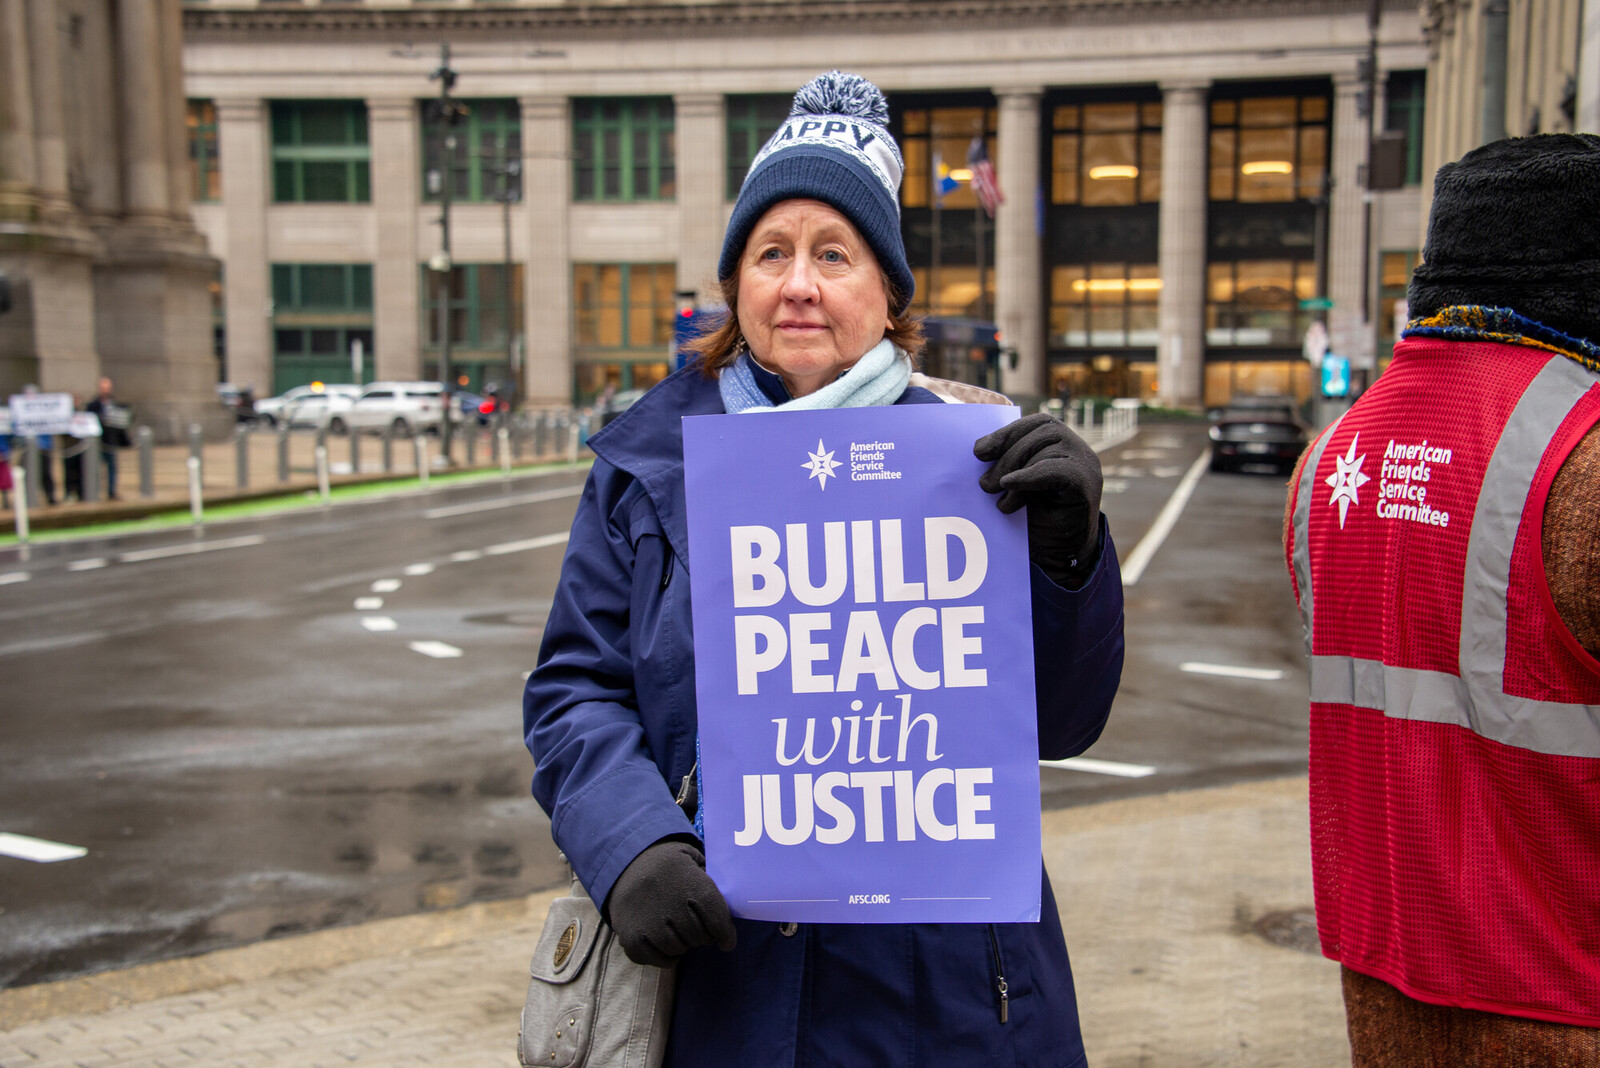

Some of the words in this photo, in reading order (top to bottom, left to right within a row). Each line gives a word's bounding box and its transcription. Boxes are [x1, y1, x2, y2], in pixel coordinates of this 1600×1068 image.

[850, 441, 895, 451] American
[850, 451, 885, 461] Friends
[1383, 439, 1453, 464] American
[850, 461, 884, 471] Service
[851, 470, 902, 481] Committee
[1381, 459, 1431, 482] Friends
[1378, 478, 1427, 502] Service
[1376, 498, 1450, 528] Committee
[730, 516, 988, 608] BUILD
[734, 605, 988, 695] PEACE
[771, 693, 944, 766] with
[734, 767, 996, 847] JUSTICE
[848, 894, 891, 904] AFSC.ORG
